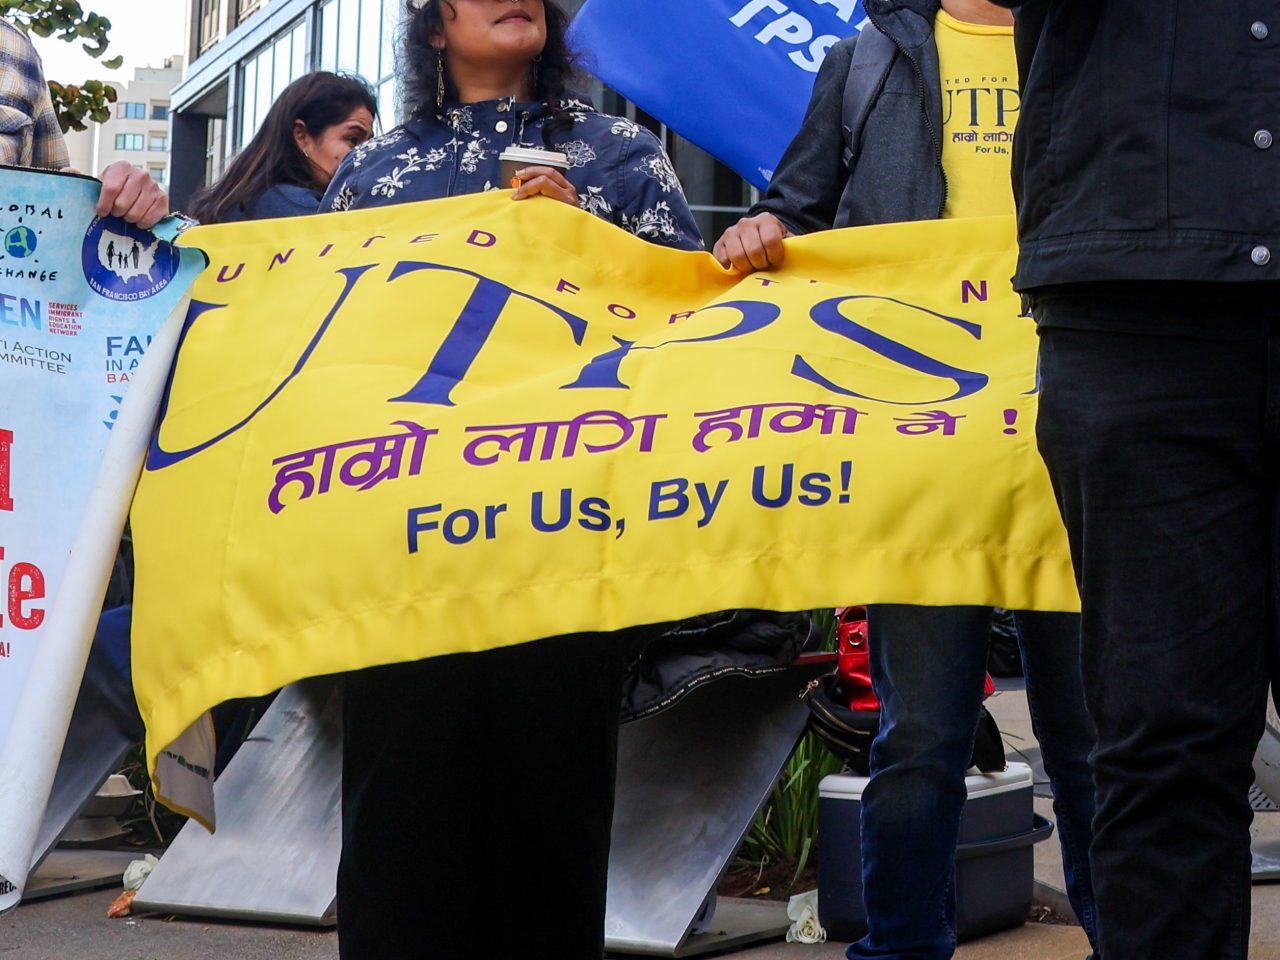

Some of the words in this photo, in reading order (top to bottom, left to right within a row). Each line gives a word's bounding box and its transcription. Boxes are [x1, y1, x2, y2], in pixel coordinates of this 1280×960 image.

[994, 146, 1009, 154] Us,
[0, 204, 64, 219] OBAL
[89, 277, 101, 292] SAN
[101, 287, 138, 300] FRANCISCO
[138, 289, 151, 298] BAY
[151, 279, 168, 293] AREA
[48, 302, 78, 311] SERVICES
[48, 309, 83, 318] IMMIGRANT
[48, 316, 70, 324] RIGHTS
[48, 322, 82, 330] EDUCATION
[49, 328, 78, 337] NETWORK
[12, 341, 72, 363] ACTION
[106, 359, 123, 371] IN
[146, 260, 1040, 471] UTPS
[107, 372, 134, 383] BA
[267, 420, 439, 515] हाम्रो
[463, 410, 668, 466] लागि
[407, 503, 507, 554] For
[531, 488, 626, 539] Us,
[647, 477, 729, 528] By
[751, 460, 852, 508] Us!
